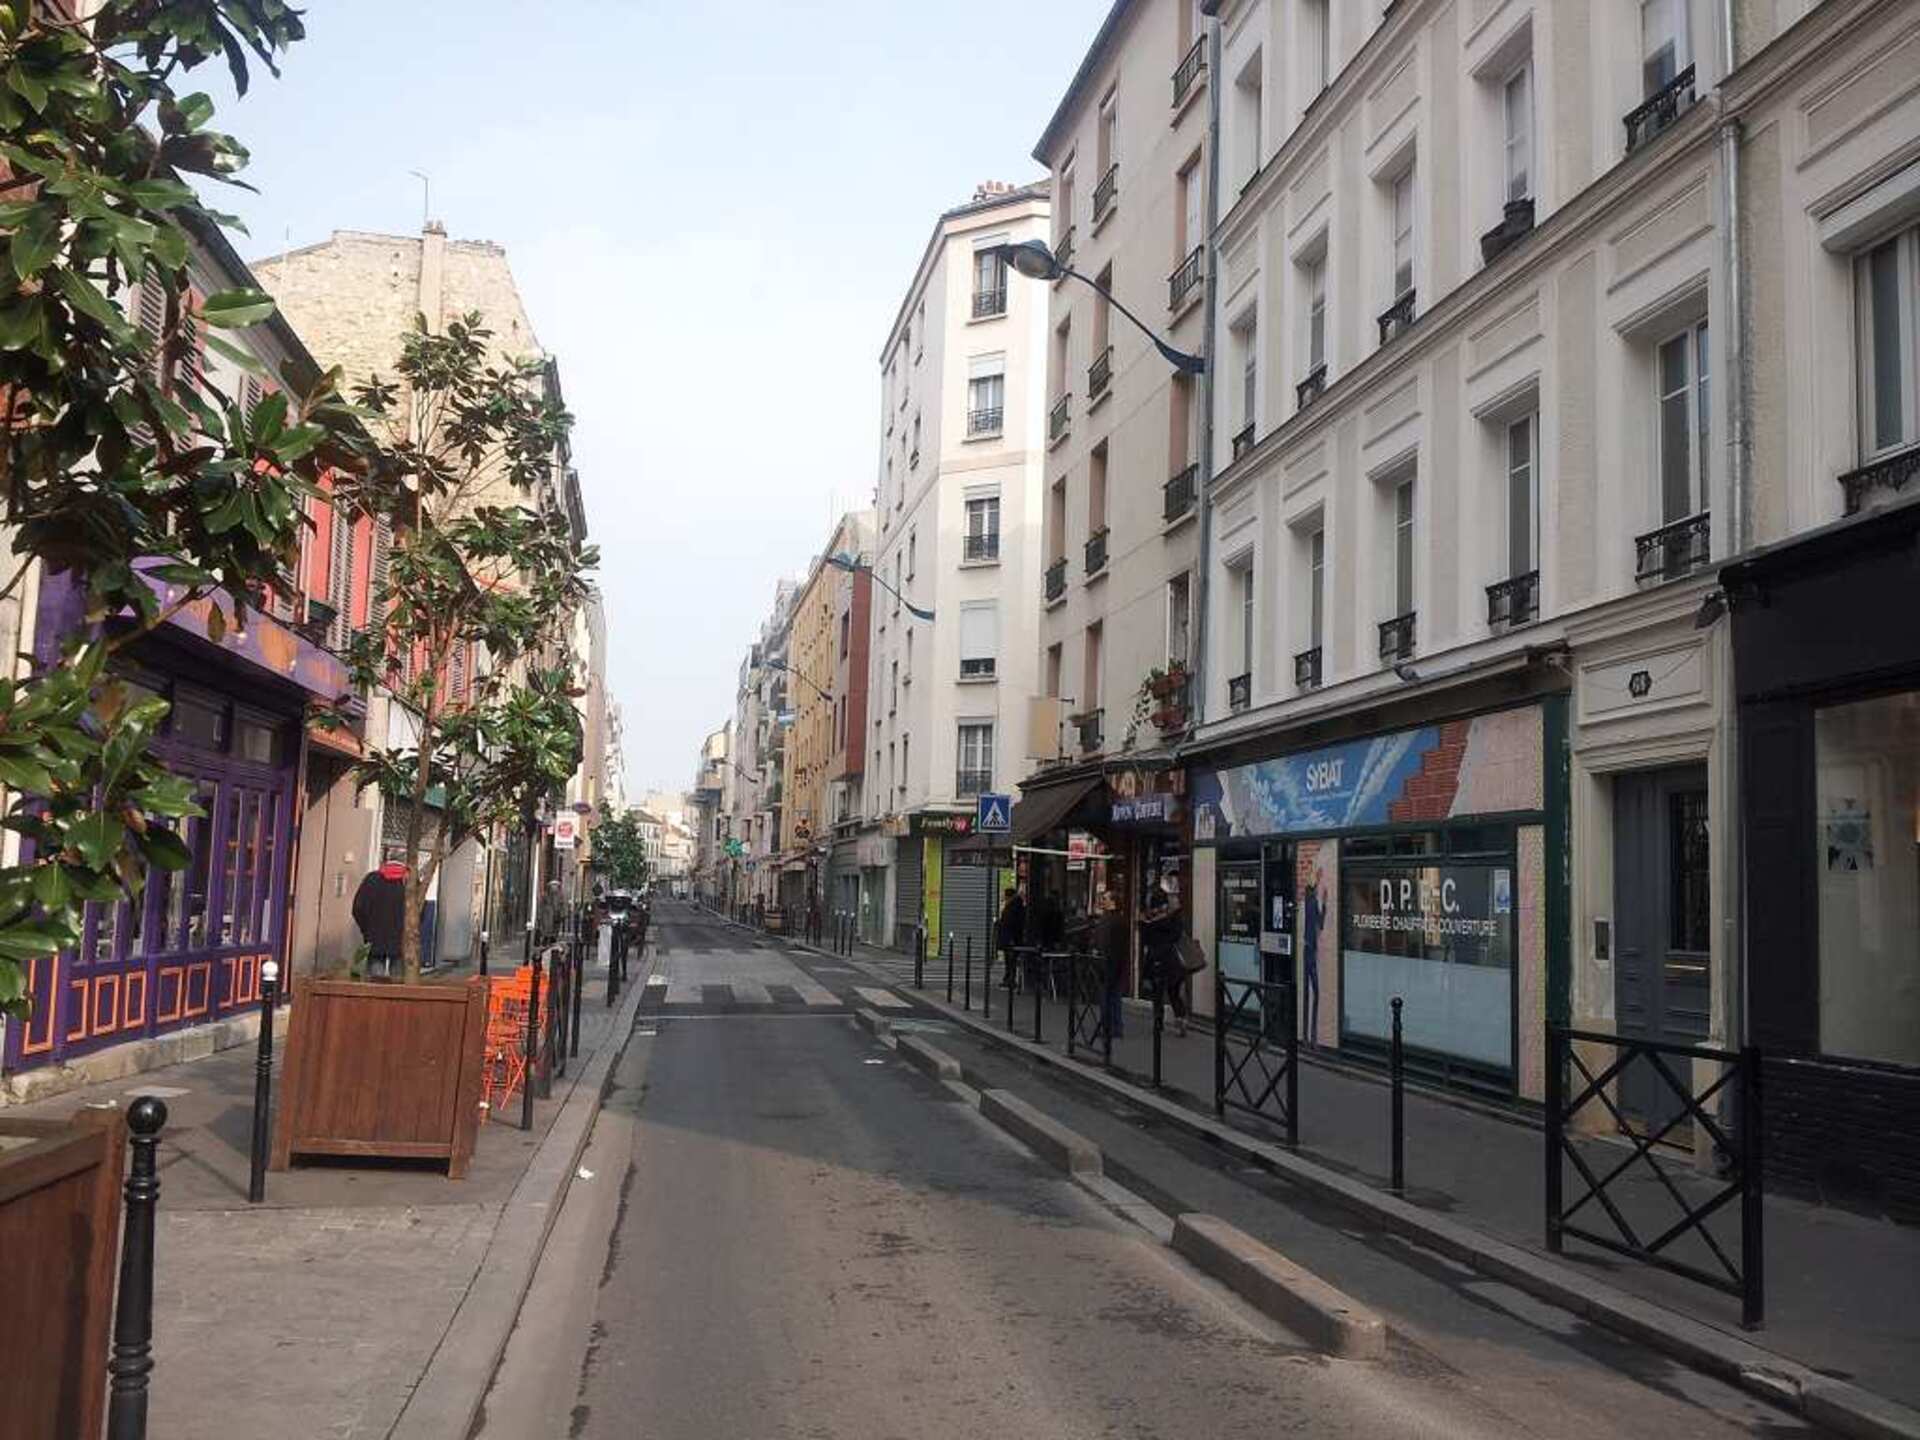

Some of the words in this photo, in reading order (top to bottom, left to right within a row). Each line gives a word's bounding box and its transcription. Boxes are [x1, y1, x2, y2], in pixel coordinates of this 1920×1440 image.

[1380, 878, 1395, 911] D.
[1400, 878, 1412, 911] P.
[1442, 877, 1461, 913] C.
